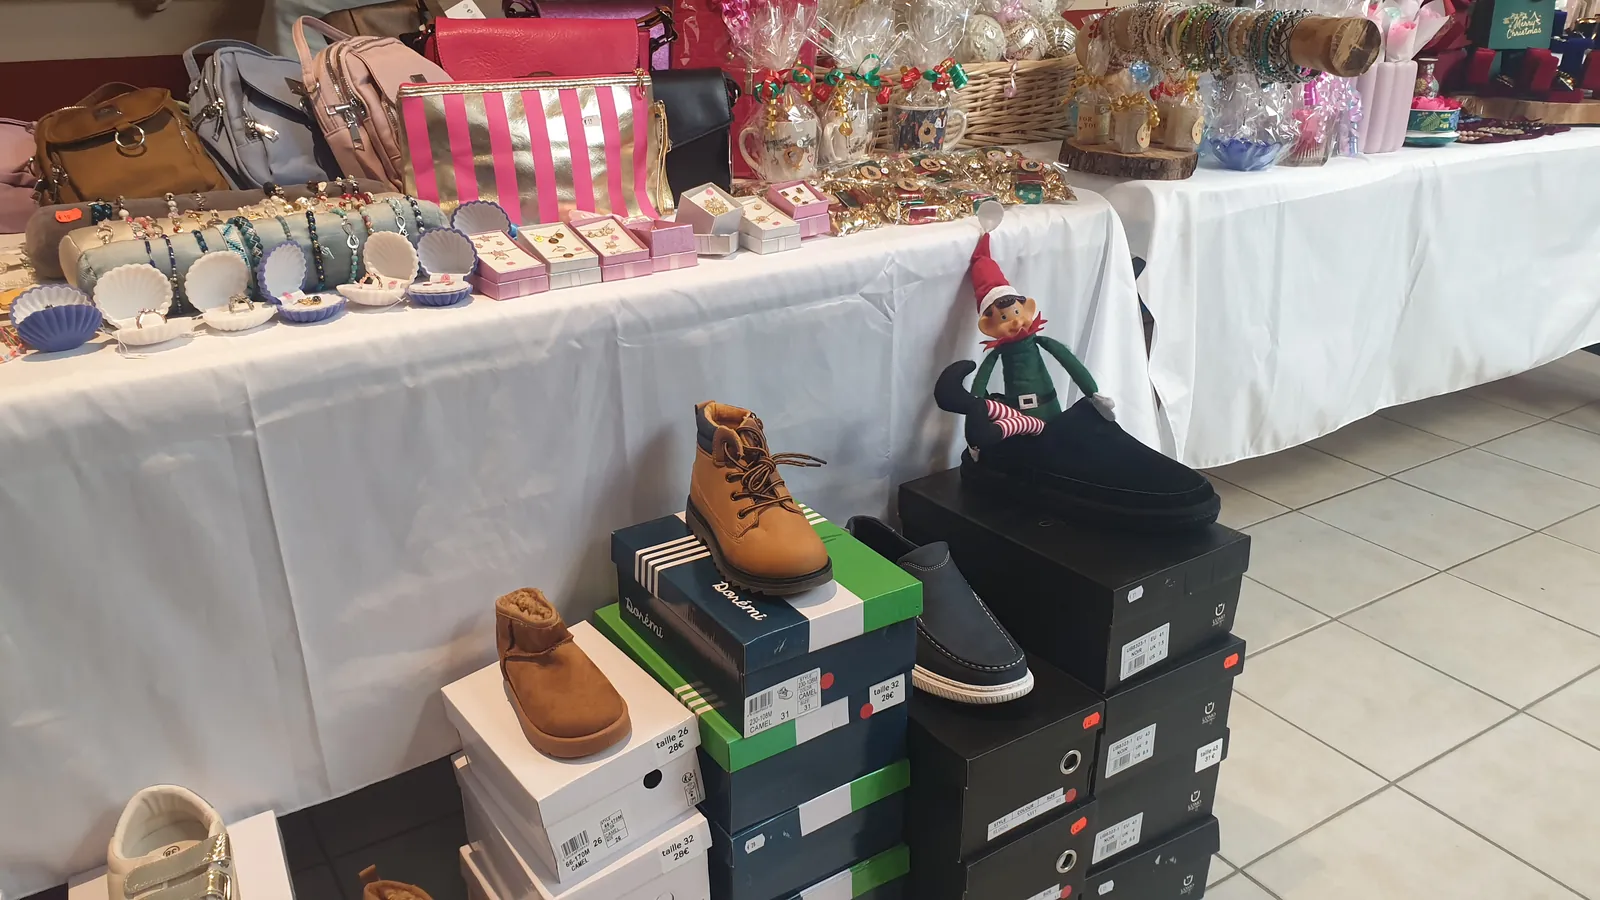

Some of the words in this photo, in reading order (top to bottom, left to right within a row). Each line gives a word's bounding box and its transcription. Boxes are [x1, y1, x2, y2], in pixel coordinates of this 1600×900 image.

[1514, 19, 1536, 30] Merry
[1507, 27, 1541, 39] Christmas
[712, 580, 767, 621] Dorémi
[625, 597, 664, 639] Dorémi
[798, 689, 817, 701] CAMEL
[873, 685, 890, 696] taille
[890, 680, 900, 689] 32
[881, 691, 894, 702] 28€
[803, 703, 811, 711] 31
[749, 711, 773, 726] 230-108M
[780, 710, 789, 720] 31
[749, 719, 772, 734] CAMEL
[656, 734, 676, 749] taille
[678, 726, 689, 738] 26
[668, 740, 684, 754] 28€
[1200, 748, 1212, 758] taille
[605, 828, 620, 836] CAMEL
[592, 836, 603, 848] 26
[661, 842, 682, 857] taille
[683, 834, 695, 846] 32
[565, 848, 590, 868] 66-170M
[673, 847, 690, 861] 28€
[571, 858, 589, 872] CAMEL
